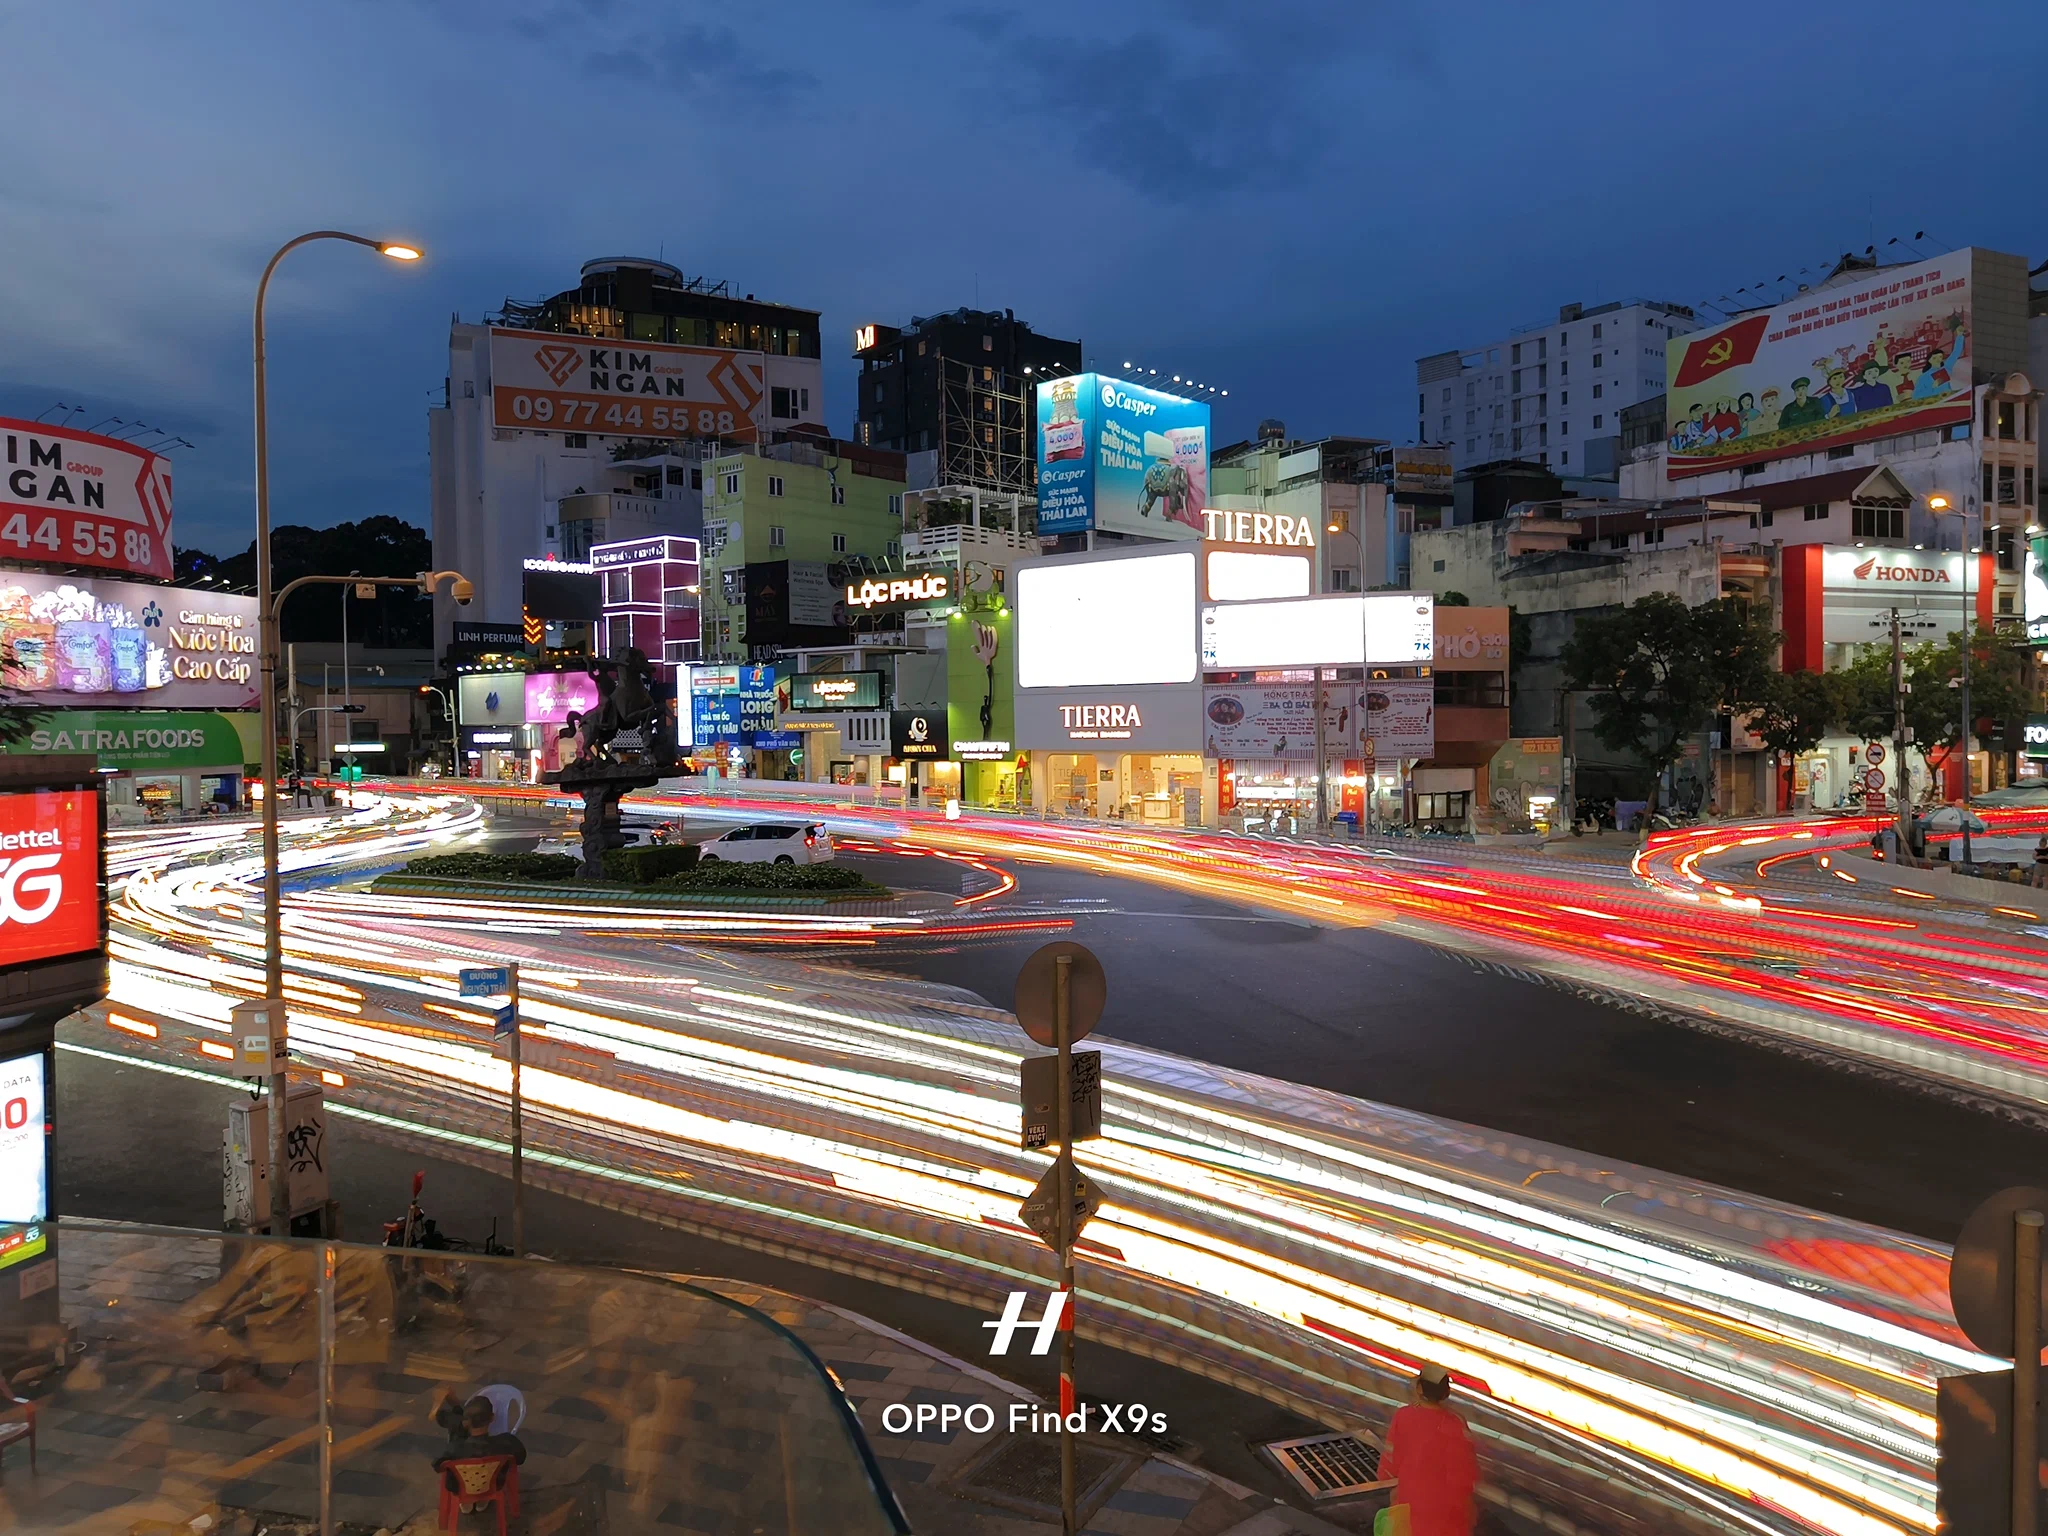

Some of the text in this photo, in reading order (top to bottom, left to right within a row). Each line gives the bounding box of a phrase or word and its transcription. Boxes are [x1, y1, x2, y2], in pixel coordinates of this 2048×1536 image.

[590, 349, 651, 373] KIM
[654, 367, 684, 375] GROUP
[590, 372, 685, 397] NGAN
[513, 395, 735, 433] 09 77 44 55 88
[1116, 391, 1157, 417] Casper
[67, 462, 103, 477] GROUP
[1052, 469, 1086, 482] Casper
[1, 513, 150, 565] 44 55 88
[1200, 509, 1315, 547] TIERRA
[1876, 565, 1950, 583] HONDA
[847, 573, 947, 609] LỘC PHÚC
[220, 630, 255, 653] Hoa
[458, 631, 524, 644] LINH PERFUME
[174, 656, 251, 685] Cao Cấp
[740, 701, 774, 714] LONG
[1059, 705, 1142, 728] TIERRA
[0, 853, 62, 925] G
[469, 971, 498, 980] ĐƯỜNG
[4, 1075, 31, 1089] DATA
[0, 1097, 27, 1129] 0
[1028, 1133, 1045, 1142] EVICT
[1029, 1125, 1045, 1134] VEKS
